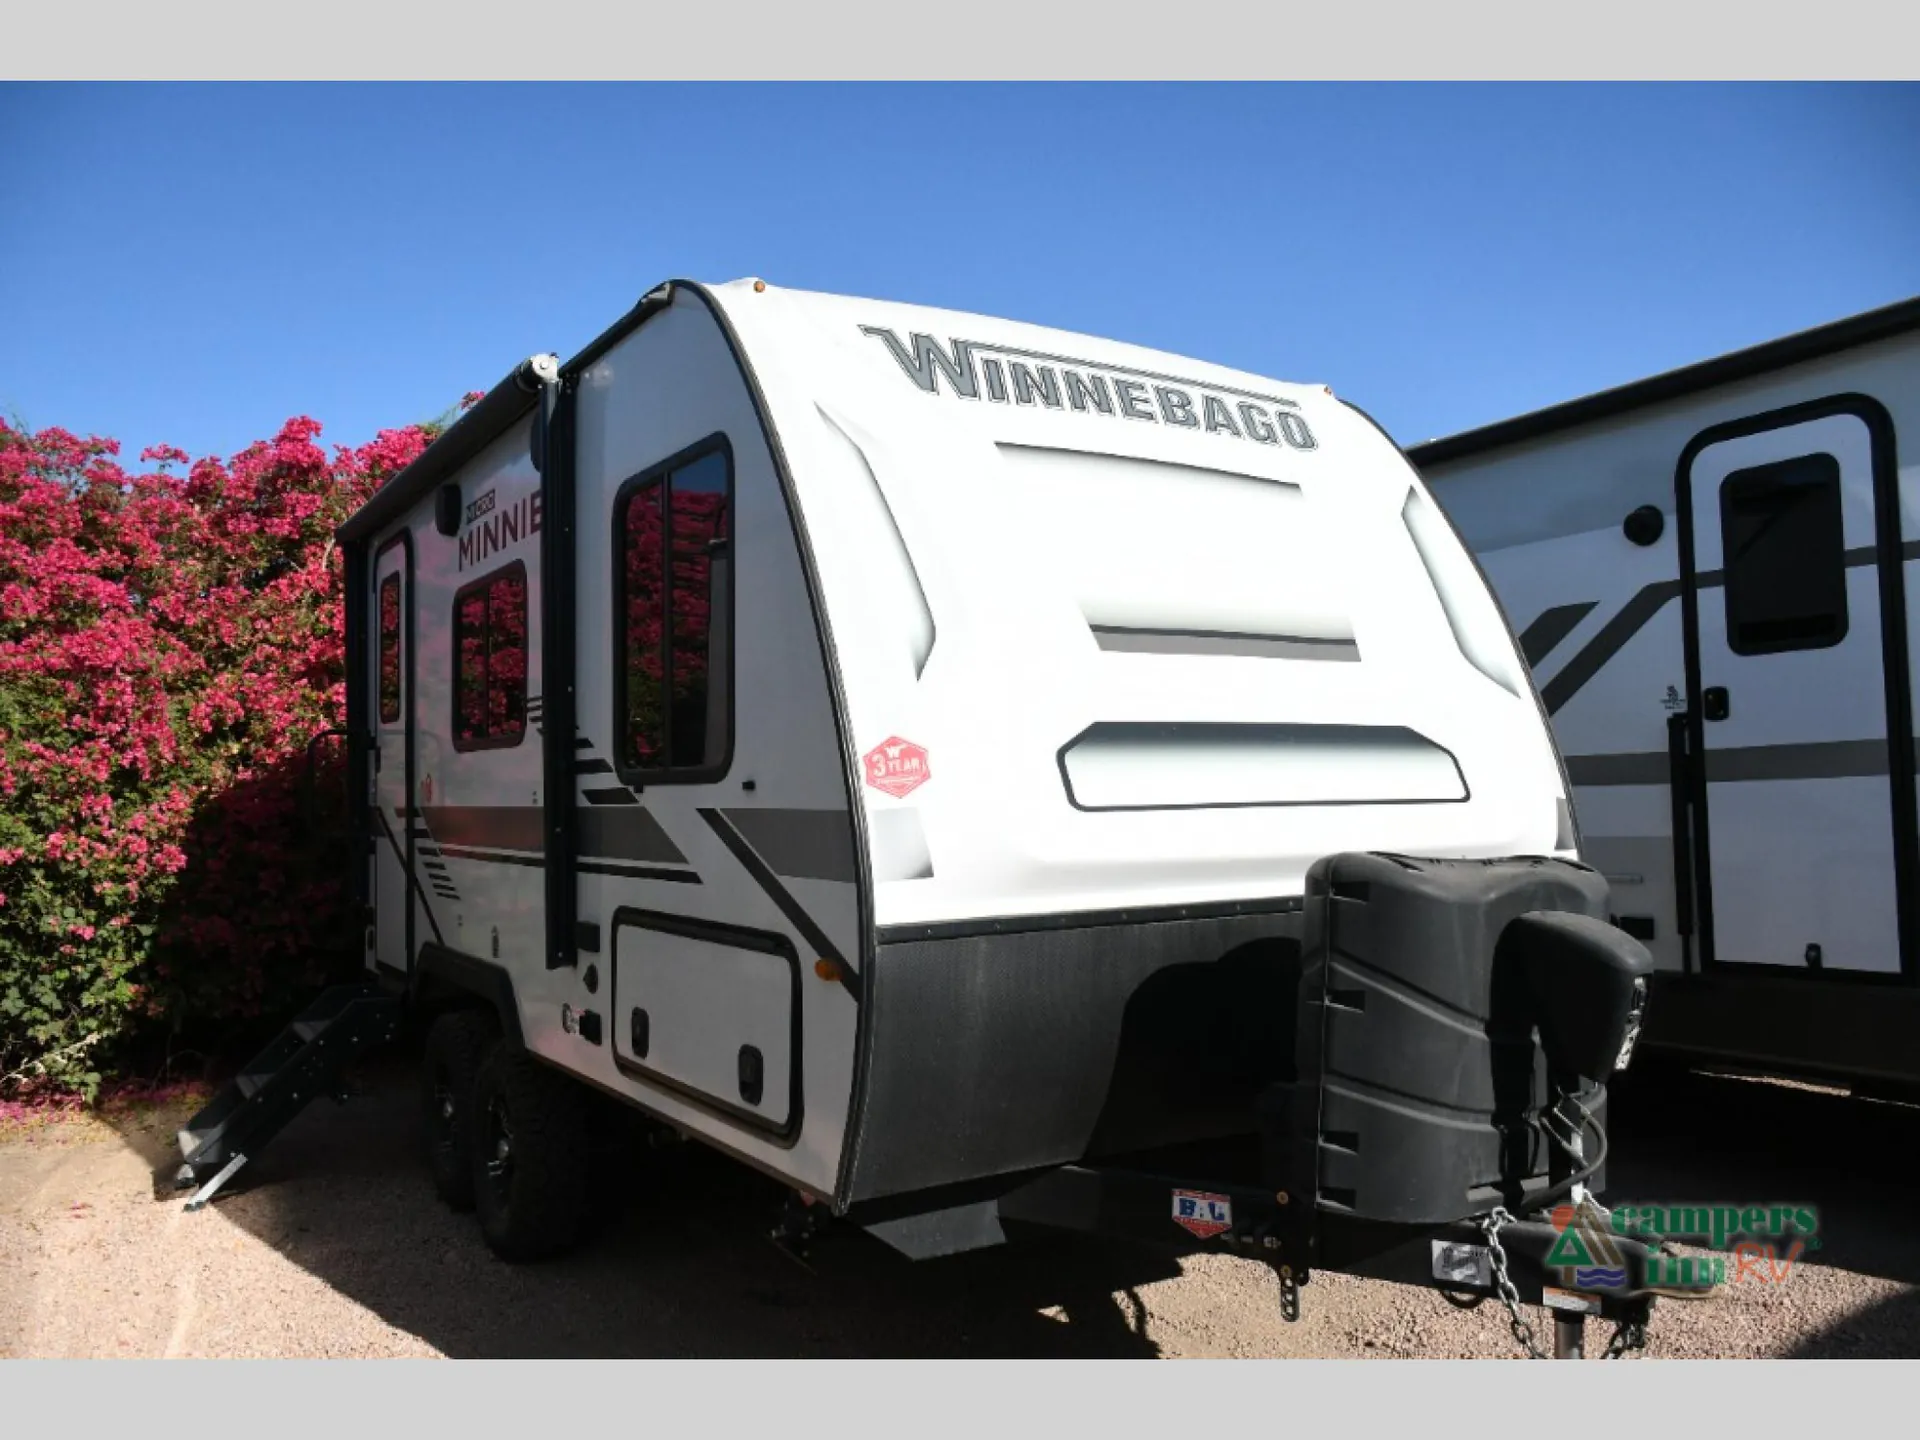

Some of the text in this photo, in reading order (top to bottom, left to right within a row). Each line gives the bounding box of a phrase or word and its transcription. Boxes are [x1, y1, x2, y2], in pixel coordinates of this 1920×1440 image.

[858, 324, 1318, 451] WINNEBAGO
[458, 489, 542, 572] MINNIE
[871, 753, 886, 777] 3
